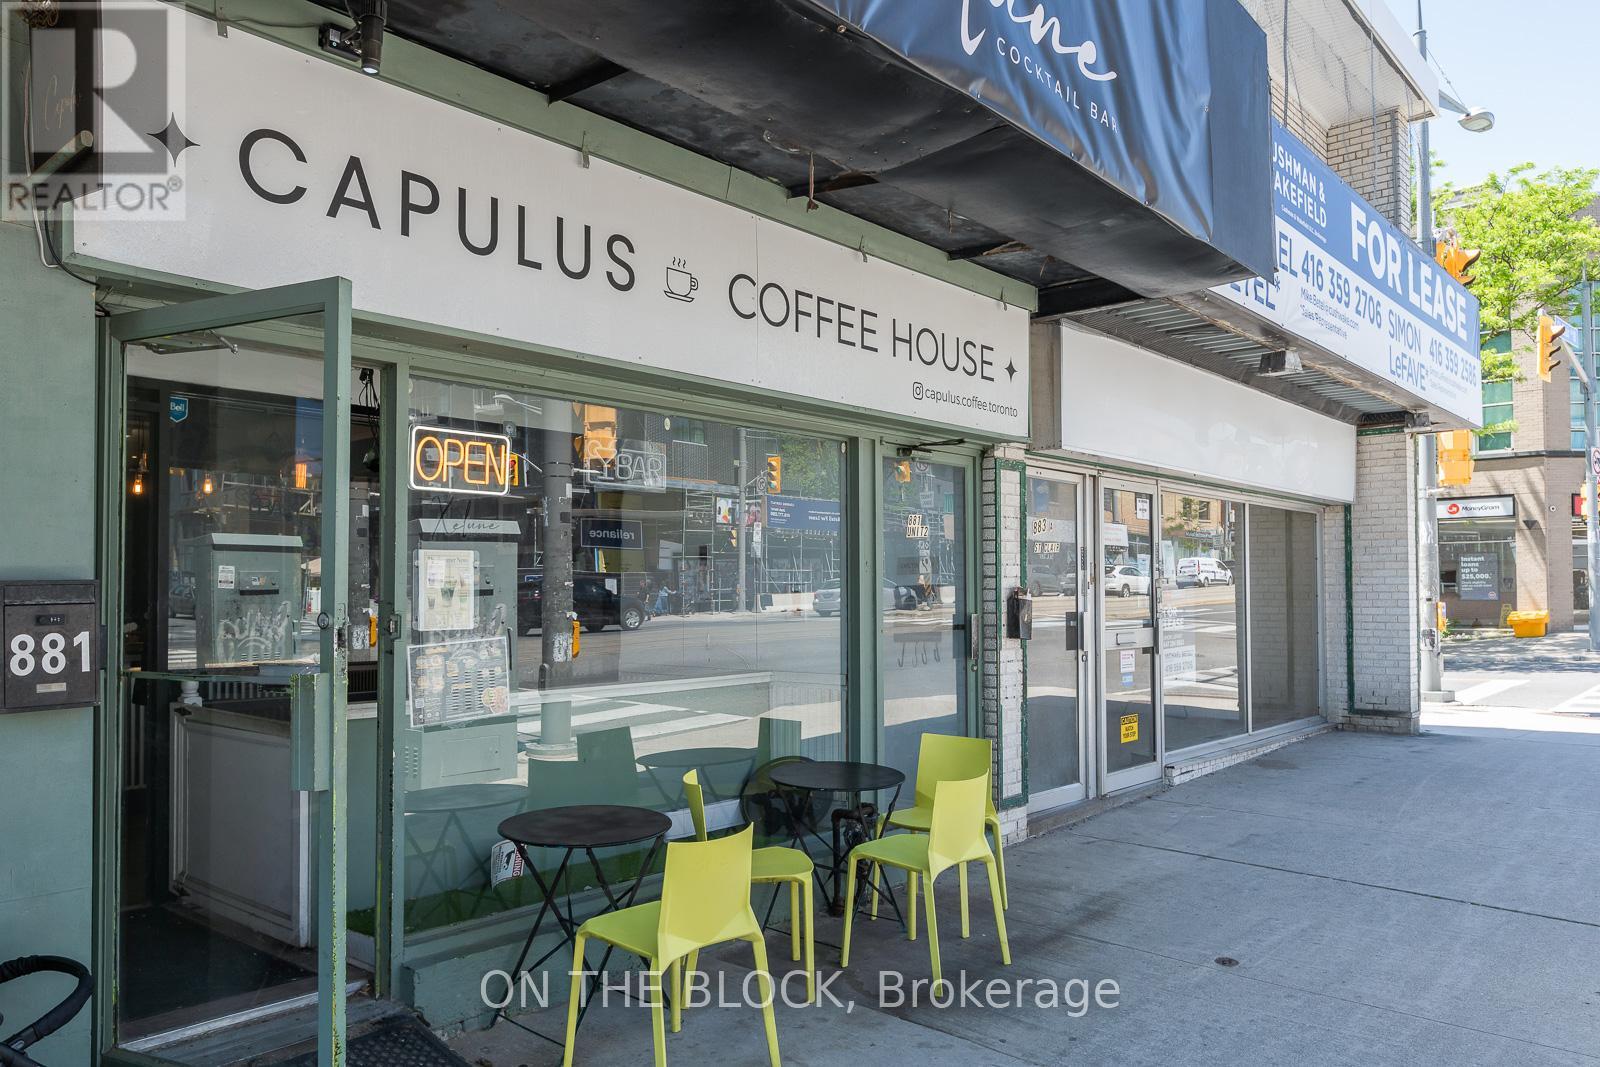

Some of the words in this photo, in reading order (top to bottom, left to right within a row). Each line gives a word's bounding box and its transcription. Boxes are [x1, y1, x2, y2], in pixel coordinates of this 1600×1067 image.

[997, 37, 1080, 109] COCKTAIL
[1090, 102, 1119, 133] BAR
[238, 128, 636, 292] CAPULUS
[1274, 170, 1327, 228] AKEFIELD
[1319, 182, 1326, 204] &
[1280, 231, 1298, 278] EL
[1302, 250, 1324, 291] 416
[1329, 266, 1350, 309] 359
[1355, 286, 1382, 329] 2706
[1350, 201, 1402, 295] FOR
[1408, 251, 1468, 342] LEASE
[728, 273, 878, 353] COFFEE
[892, 318, 995, 382] HOUSE
[1389, 309, 1421, 355] SIMON
[1430, 338, 1442, 367] 416
[1445, 346, 1458, 376] 359
[170, 401, 185, 411] Bell
[925, 388, 1018, 418] capulus.coffee.toronto
[416, 436, 506, 485] OPEN
[908, 515, 922, 526] 881
[1033, 518, 1047, 534] 883
[9, 631, 91, 676] 881
